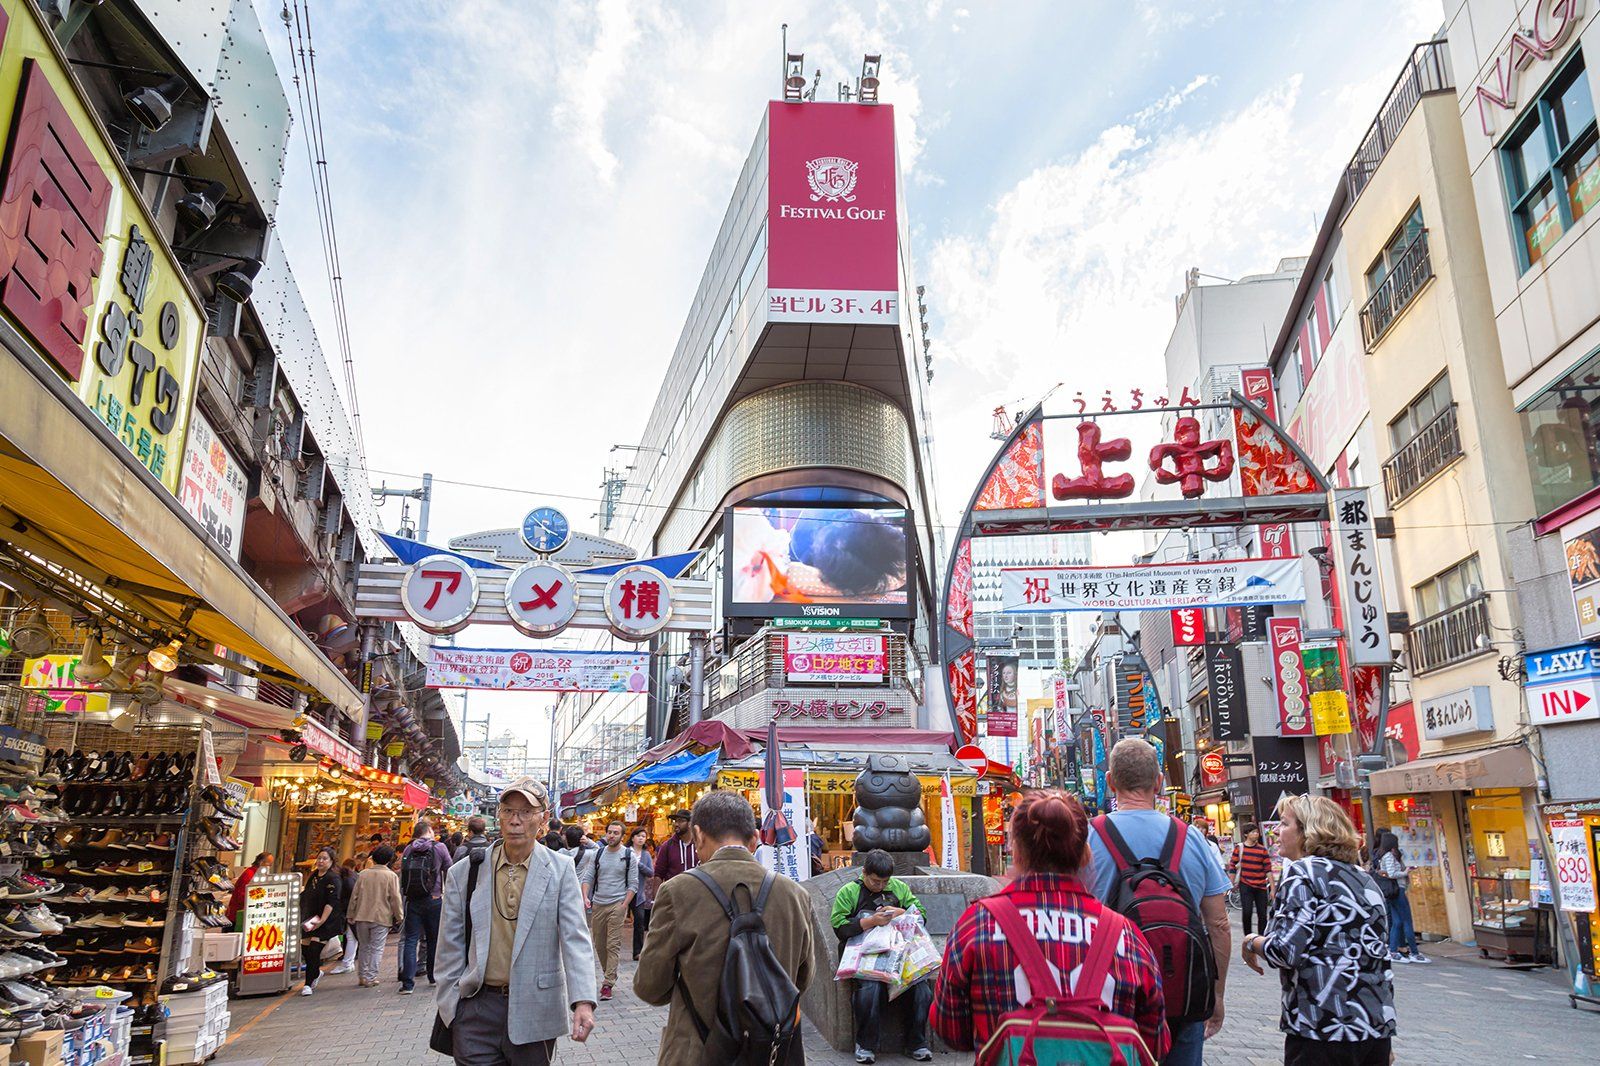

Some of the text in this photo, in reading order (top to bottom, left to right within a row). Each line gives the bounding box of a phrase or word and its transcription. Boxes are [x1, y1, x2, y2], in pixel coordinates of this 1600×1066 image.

[1476, 0, 1584, 136] NAG
[780, 205, 886, 221] FESTIVAL GOLF
[1072, 386, 1200, 414] うえちゅん
[1060, 576, 1237, 599] 世界文化遺産登録
[1339, 499, 1380, 650] 都まんじゅう
[421, 570, 661, 620] アメ横
[1022, 577, 1052, 604] 祝
[1082, 595, 1210, 608] WORLD CULTURAL HERITAGE
[31, 660, 83, 689] SAL
[512, 655, 530, 672] 祝
[534, 658, 573, 673] 記念祭
[771, 699, 905, 720] アメ横センター
[1125, 674, 1145, 728] フラ
[1214, 664, 1232, 737] ROOMPIA
[1542, 690, 1572, 717] IN
[1425, 699, 1472, 731] 都まんじゅう
[4, 737, 46, 756] SKECHERS
[1258, 761, 1304, 771] カンタン
[1259, 773, 1305, 783] 部屋さがし
[1558, 858, 1588, 884] 839
